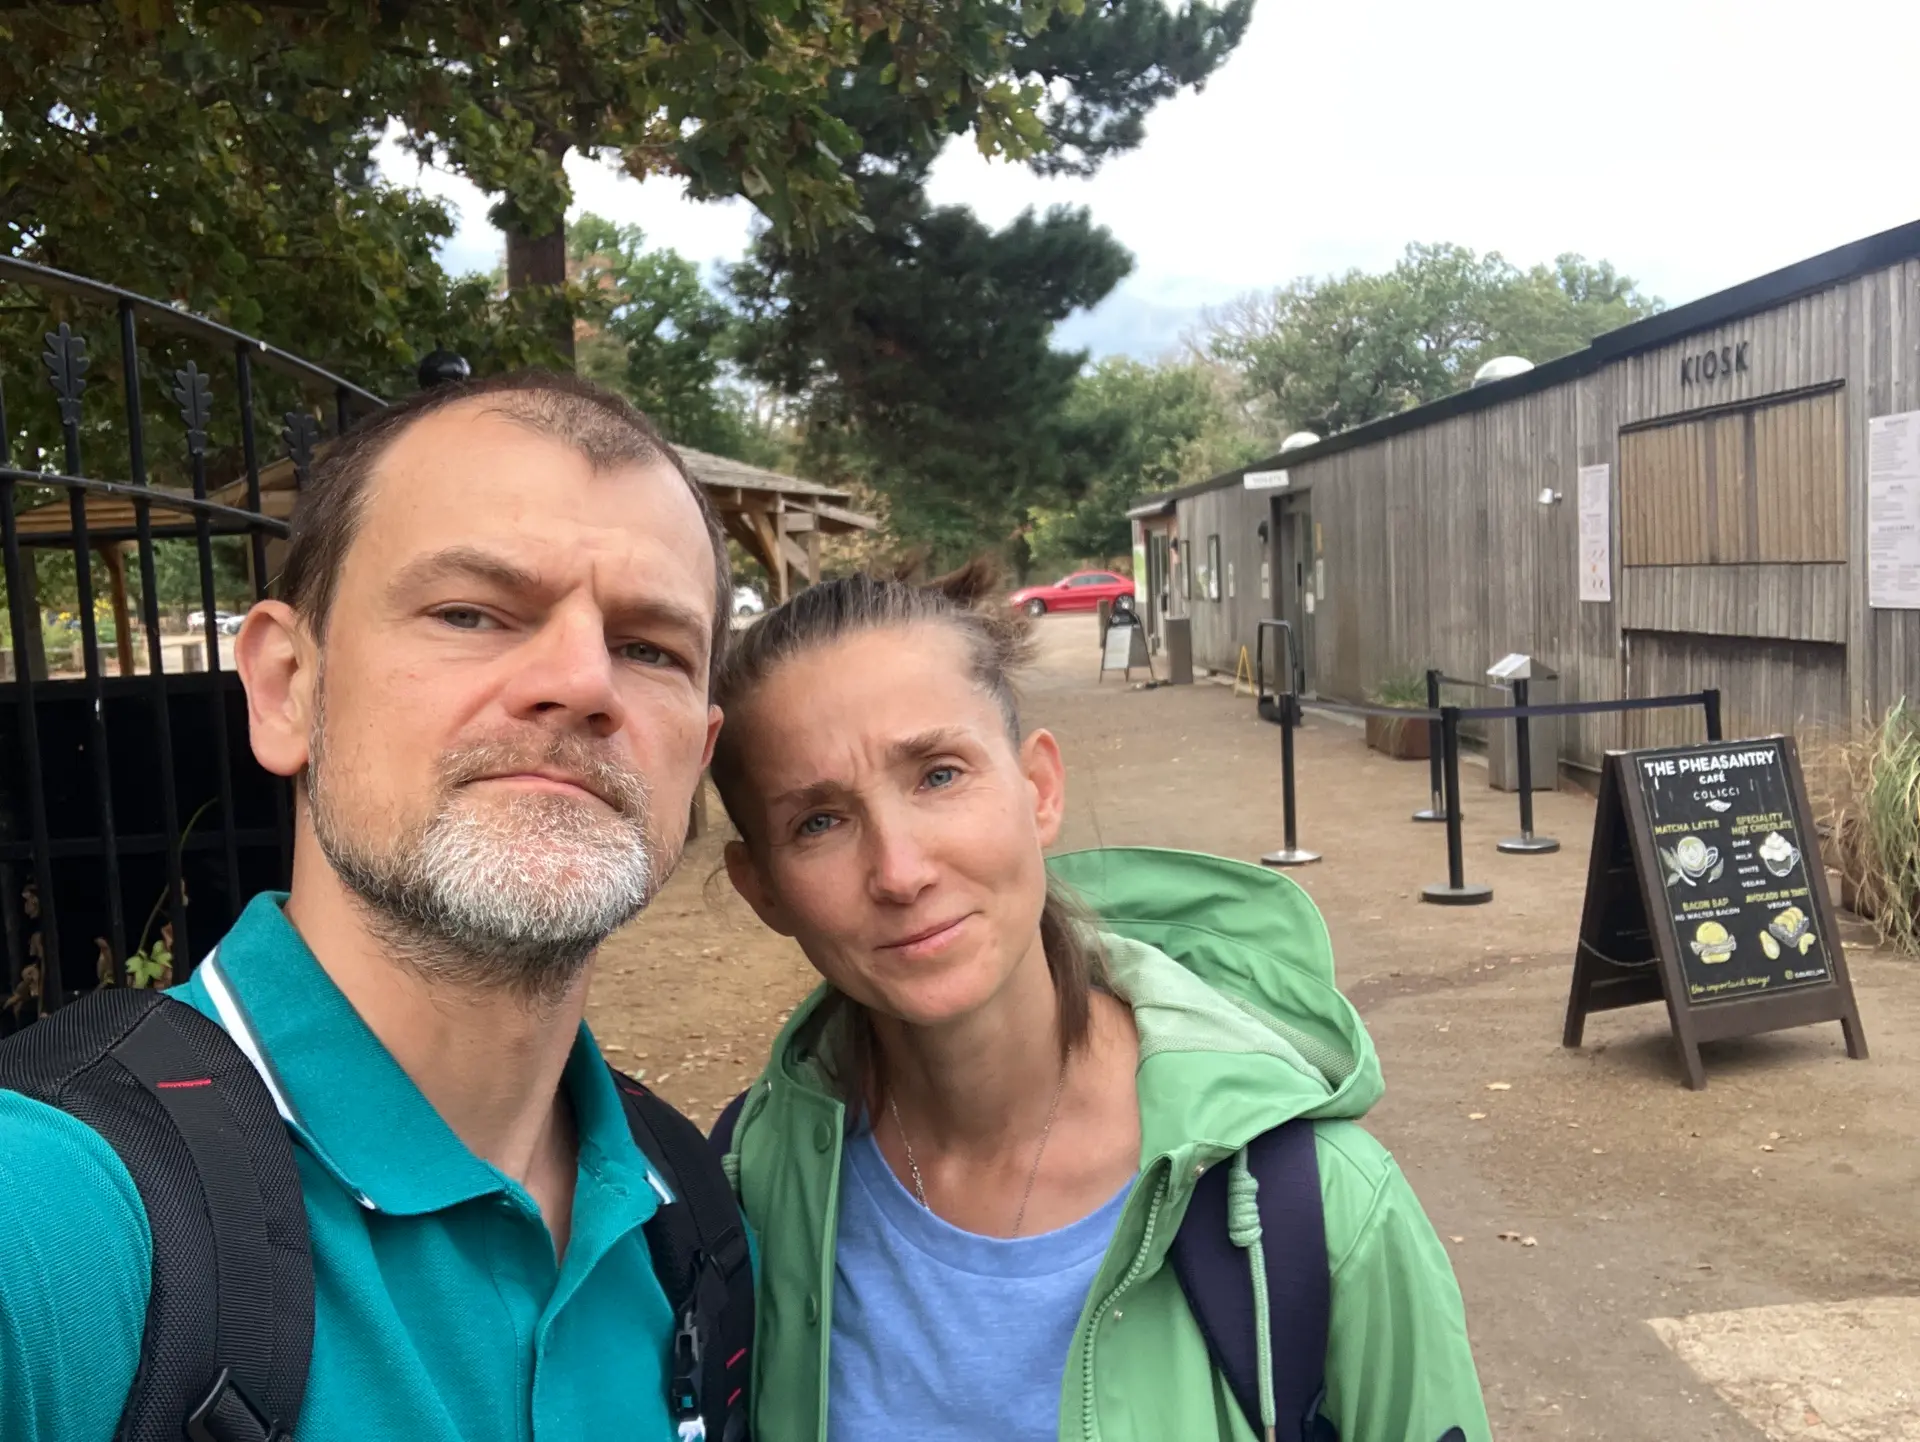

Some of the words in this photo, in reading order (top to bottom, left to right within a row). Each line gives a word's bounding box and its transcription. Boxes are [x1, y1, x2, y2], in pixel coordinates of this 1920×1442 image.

[1681, 341, 1749, 388] KIOSK
[1644, 761, 1676, 777] THE
[1679, 750, 1775, 774] PHEASANTRY
[1699, 770, 1726, 785] CAFÉ
[1693, 787, 1740, 801] COLICCI
[1736, 812, 1783, 825] SPECIALITY
[1655, 823, 1690, 835] MATCHA
[1692, 819, 1720, 831] LATTE
[1731, 825, 1749, 836] HOT
[1750, 820, 1793, 832] CHOCOLATE
[1682, 899, 1710, 912] BACON
